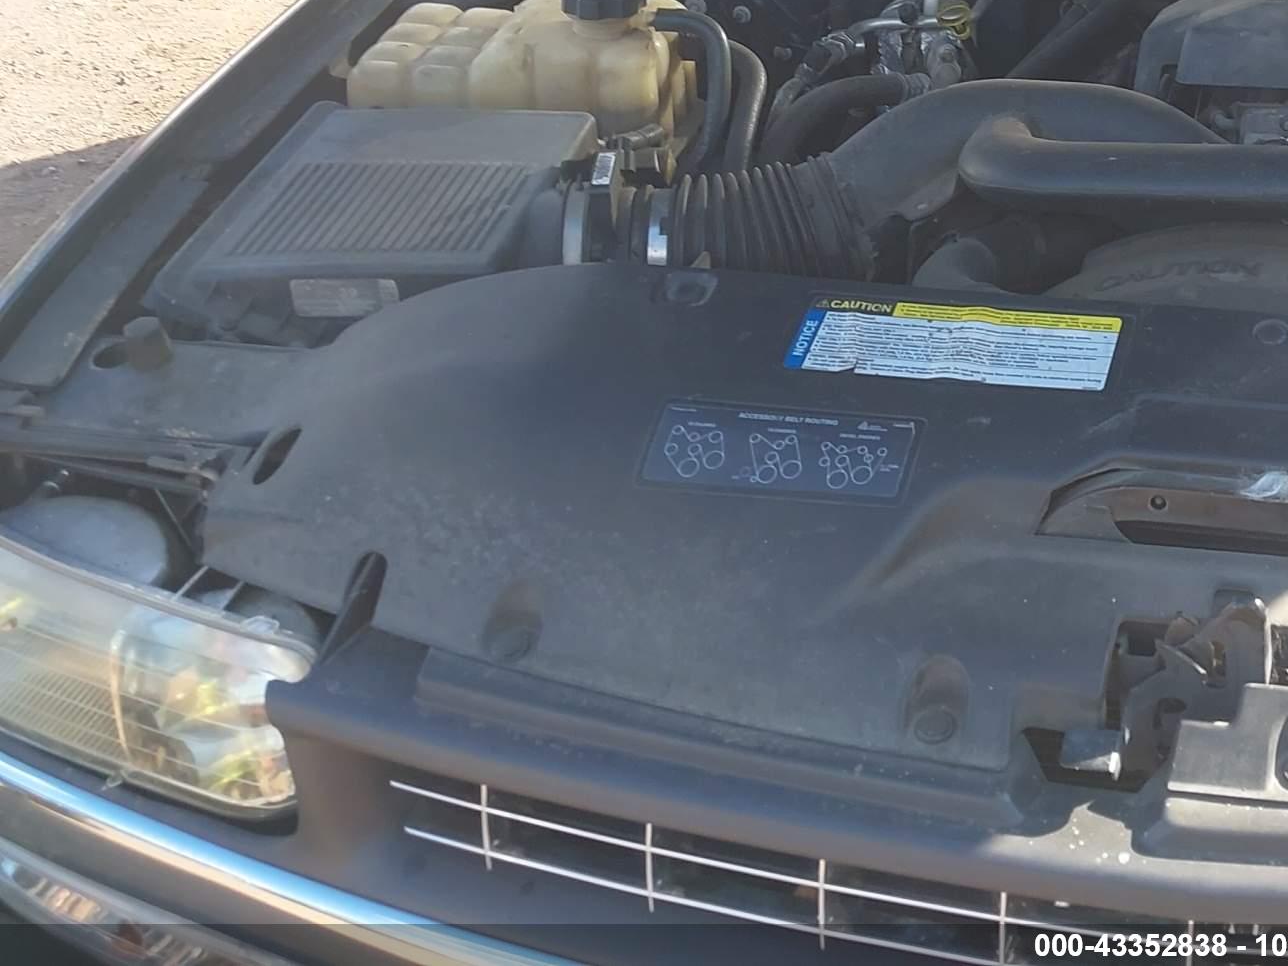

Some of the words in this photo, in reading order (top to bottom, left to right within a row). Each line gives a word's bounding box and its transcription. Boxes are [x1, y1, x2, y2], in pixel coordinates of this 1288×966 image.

[830, 300, 893, 313] CAUTION
[792, 320, 819, 356] NOTICE
[738, 412, 784, 421] ACCESSORY
[785, 415, 804, 423] BELT
[805, 417, 839, 426] ROUTING
